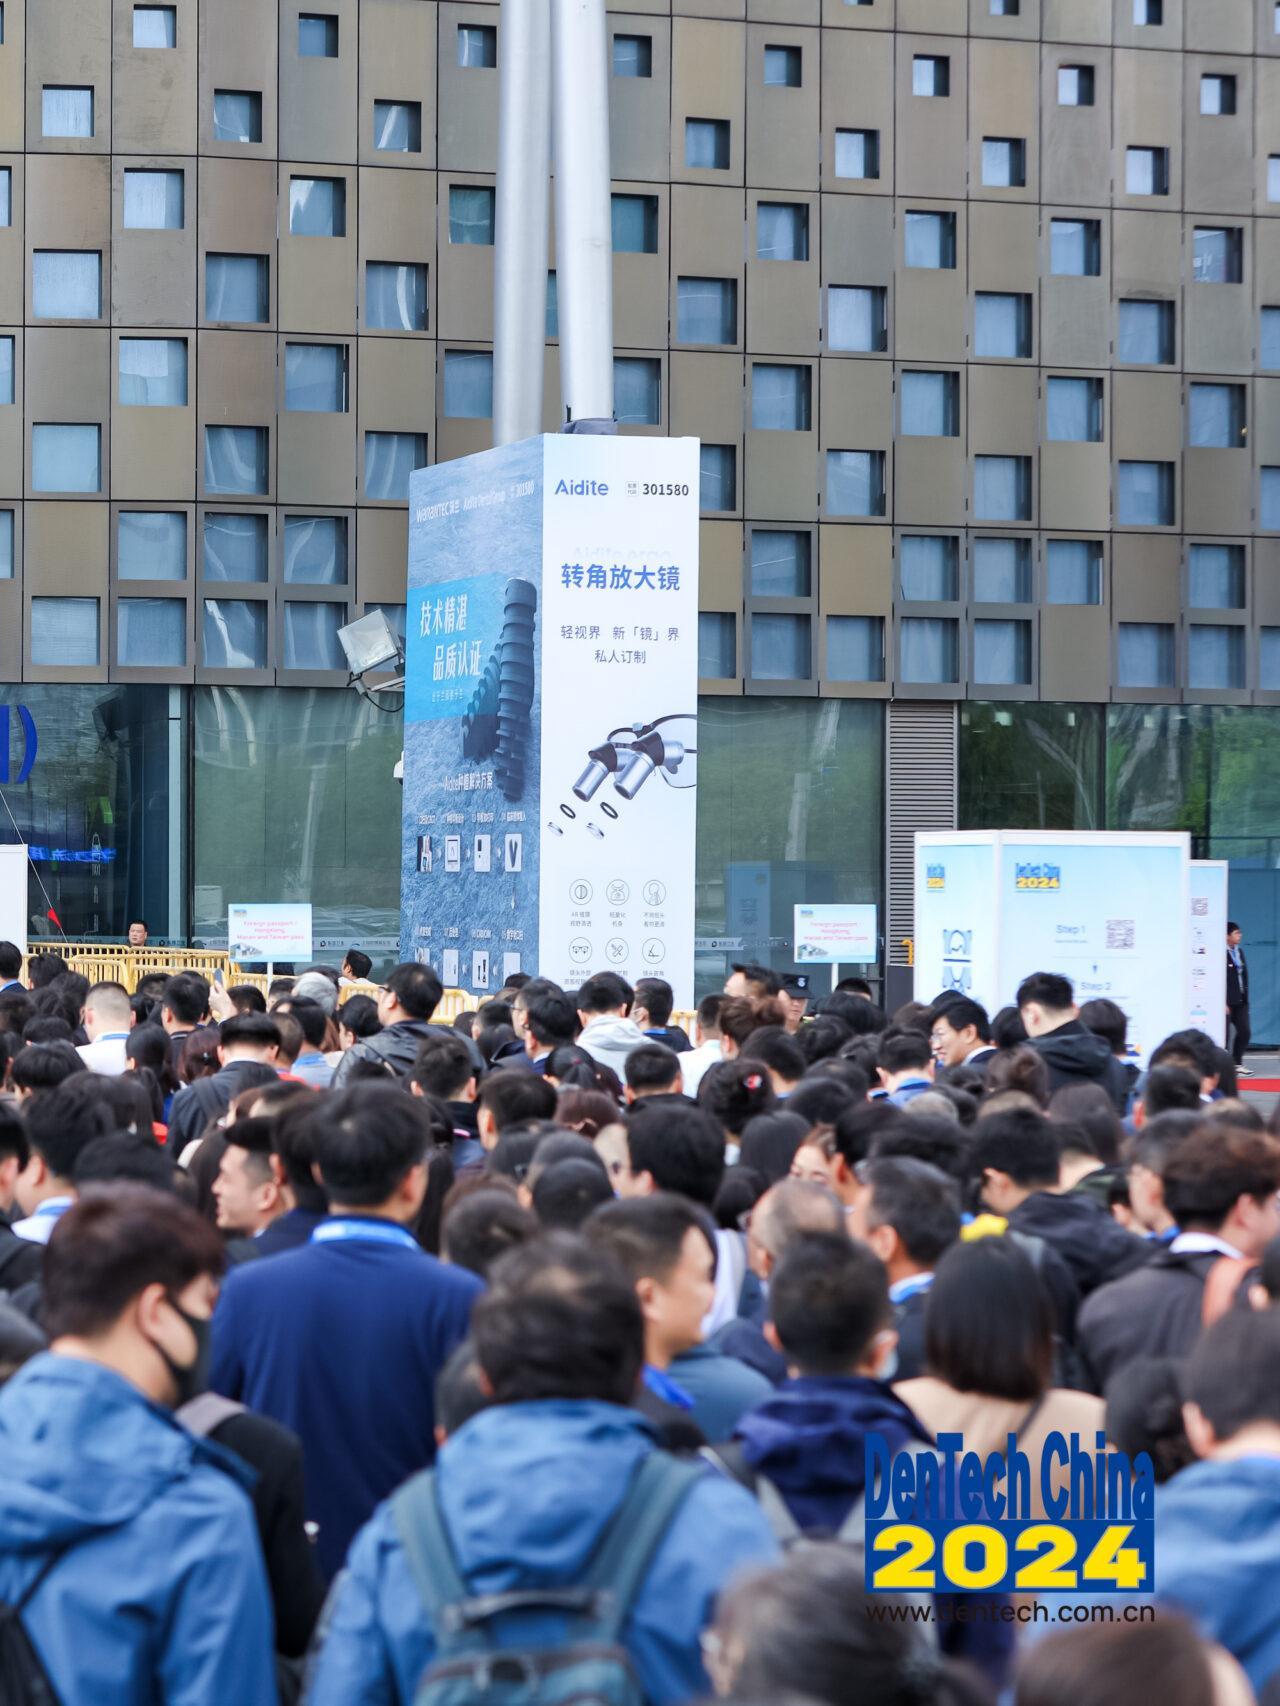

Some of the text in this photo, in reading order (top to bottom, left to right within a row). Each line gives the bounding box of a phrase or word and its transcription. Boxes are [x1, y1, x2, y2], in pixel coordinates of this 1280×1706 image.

[555, 479, 609, 496] Aidite
[642, 483, 689, 496] 301580
[560, 563, 680, 591] 转角放大镜
[420, 593, 468, 638] 技术精湛
[560, 625, 601, 640] 轻视界
[433, 639, 482, 682] 品质认证
[594, 650, 647, 664] 私人订制
[1016, 877, 1060, 888] 2024
[1056, 924, 1080, 936] Step
